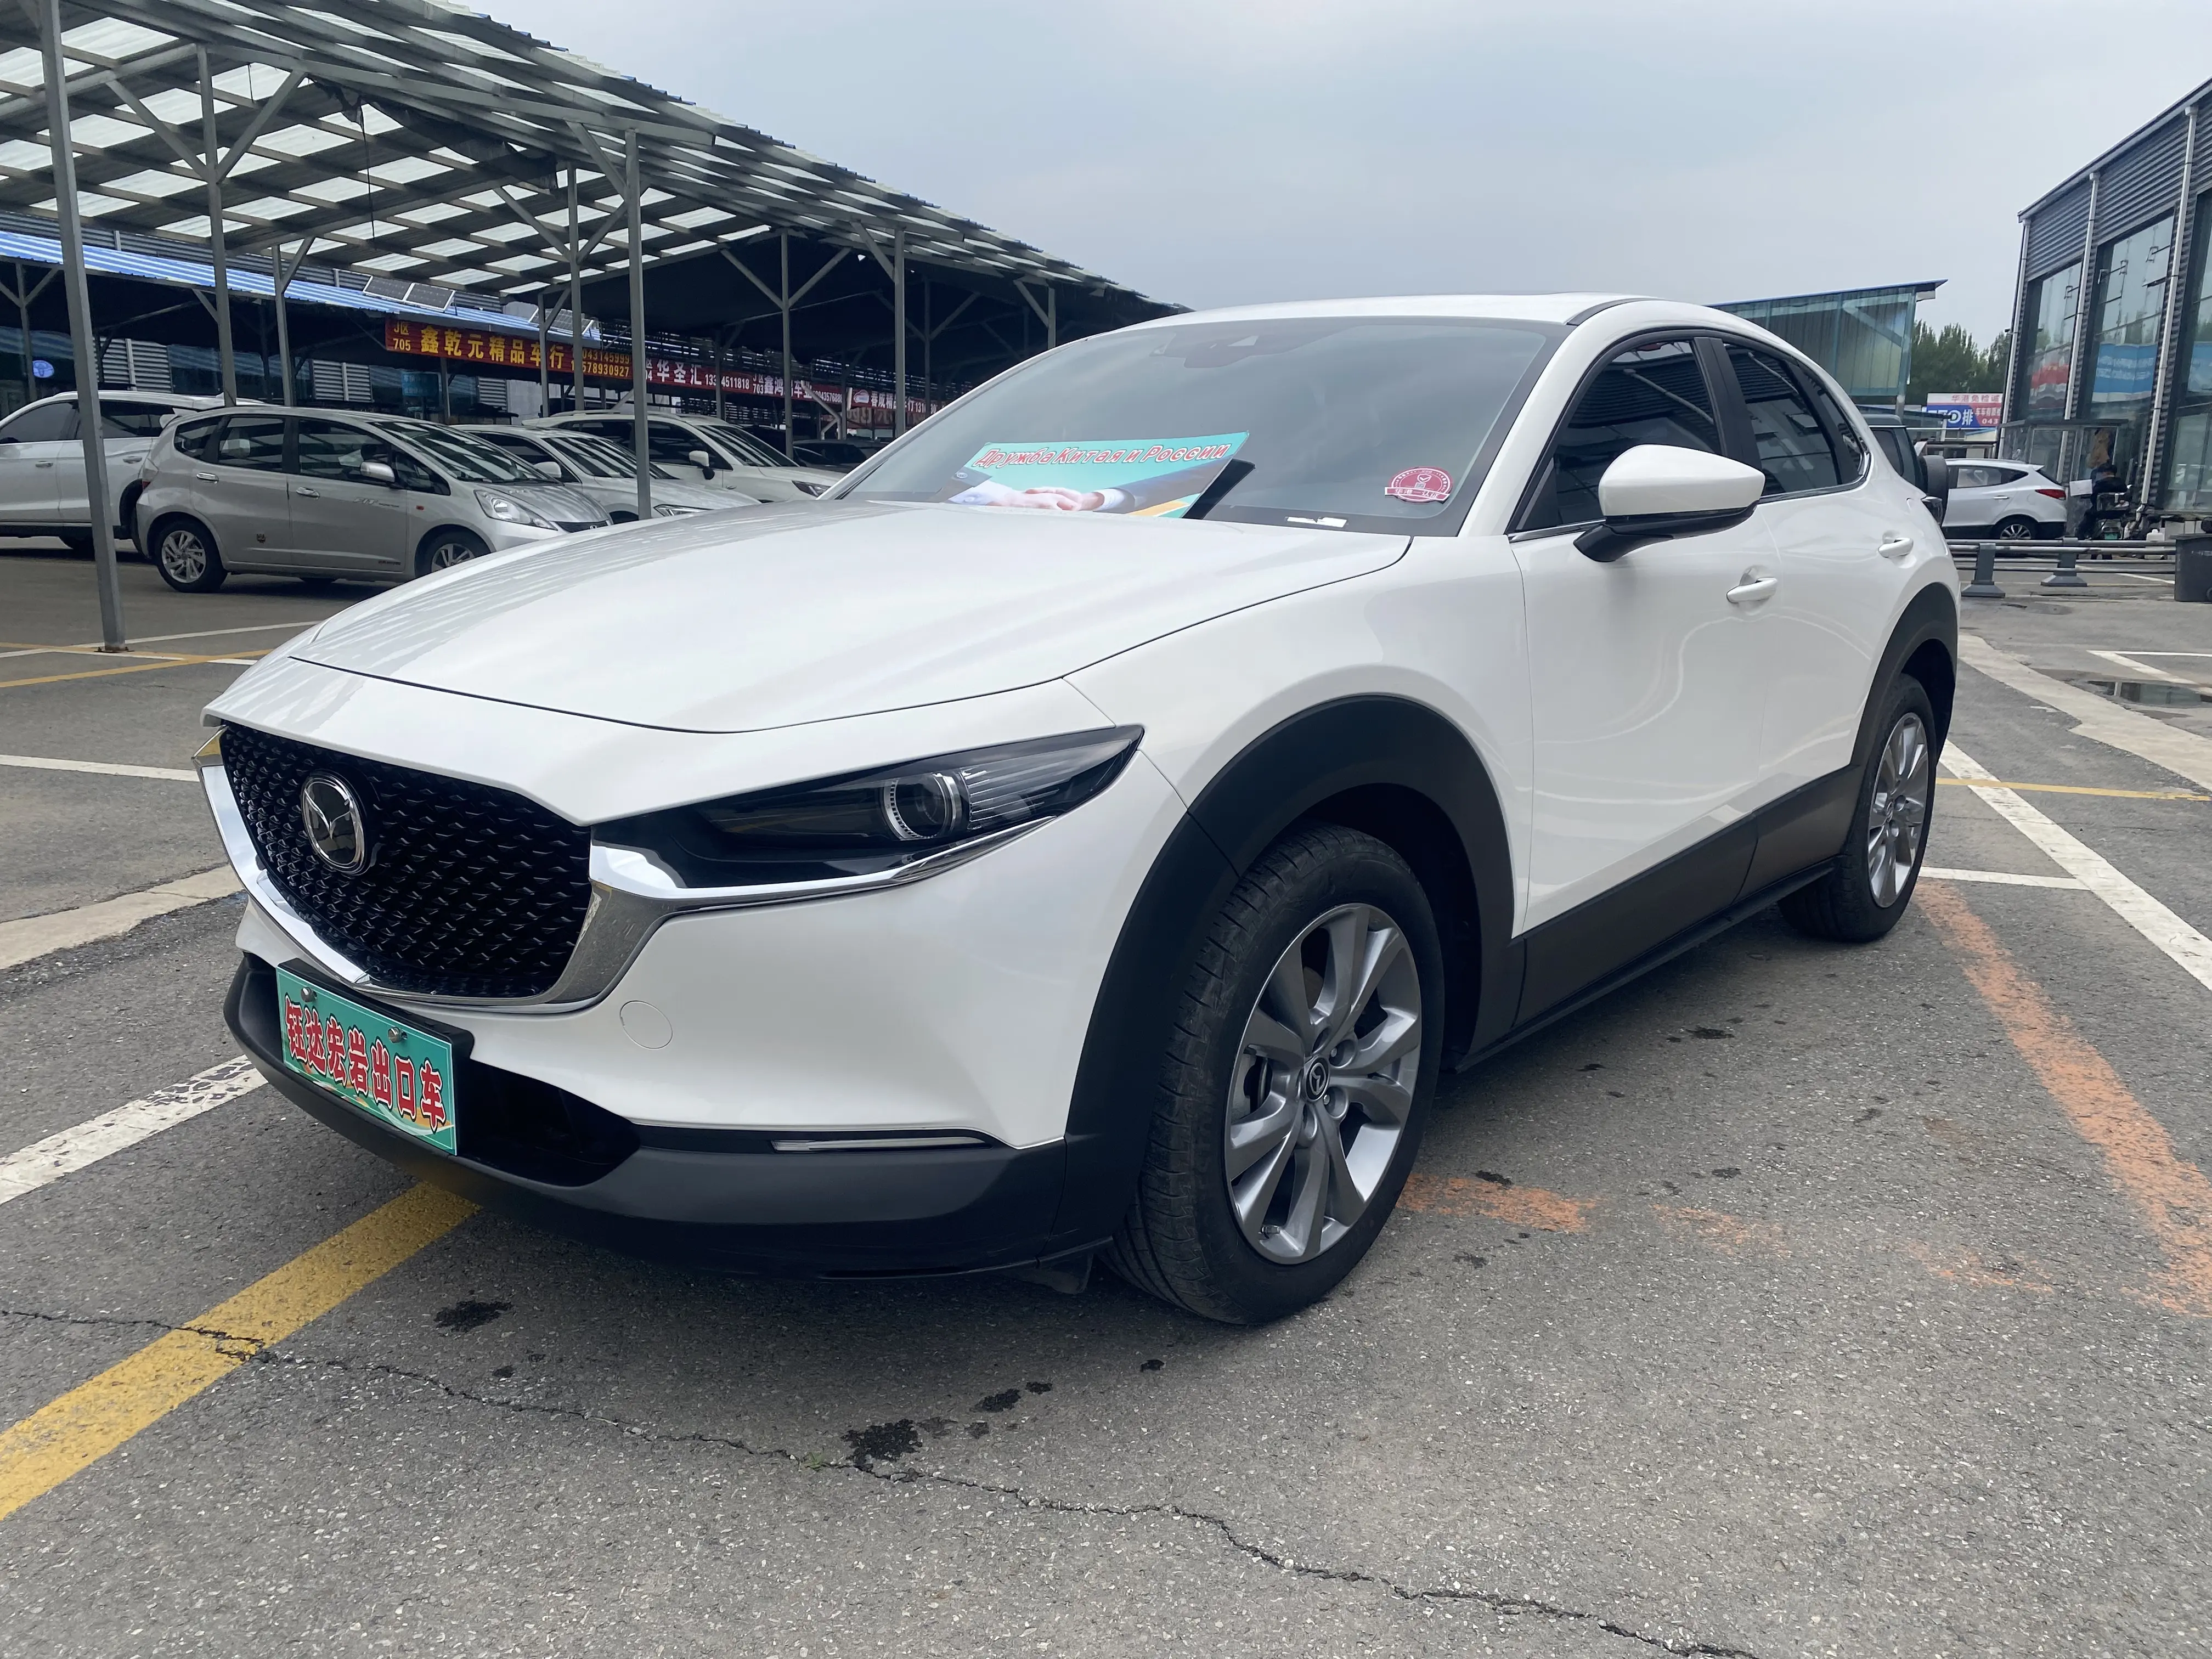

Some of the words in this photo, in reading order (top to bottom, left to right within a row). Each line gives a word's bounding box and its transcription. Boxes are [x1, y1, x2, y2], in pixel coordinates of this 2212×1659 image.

[394, 321, 409, 335] J区
[393, 338, 411, 351] 705
[421, 325, 564, 369] 鑫乾元精品车行
[571, 360, 629, 377] 1578930927
[657, 359, 702, 386] 华圣汇
[705, 374, 749, 390] 1334511818
[753, 383, 764, 394] 703
[972, 447, 1056, 469] Дружба
[1052, 447, 1122, 466] Китая
[1122, 449, 1142, 464] и
[1139, 443, 1232, 463] России
[284, 993, 447, 1134] 钰达宏岩出口车
